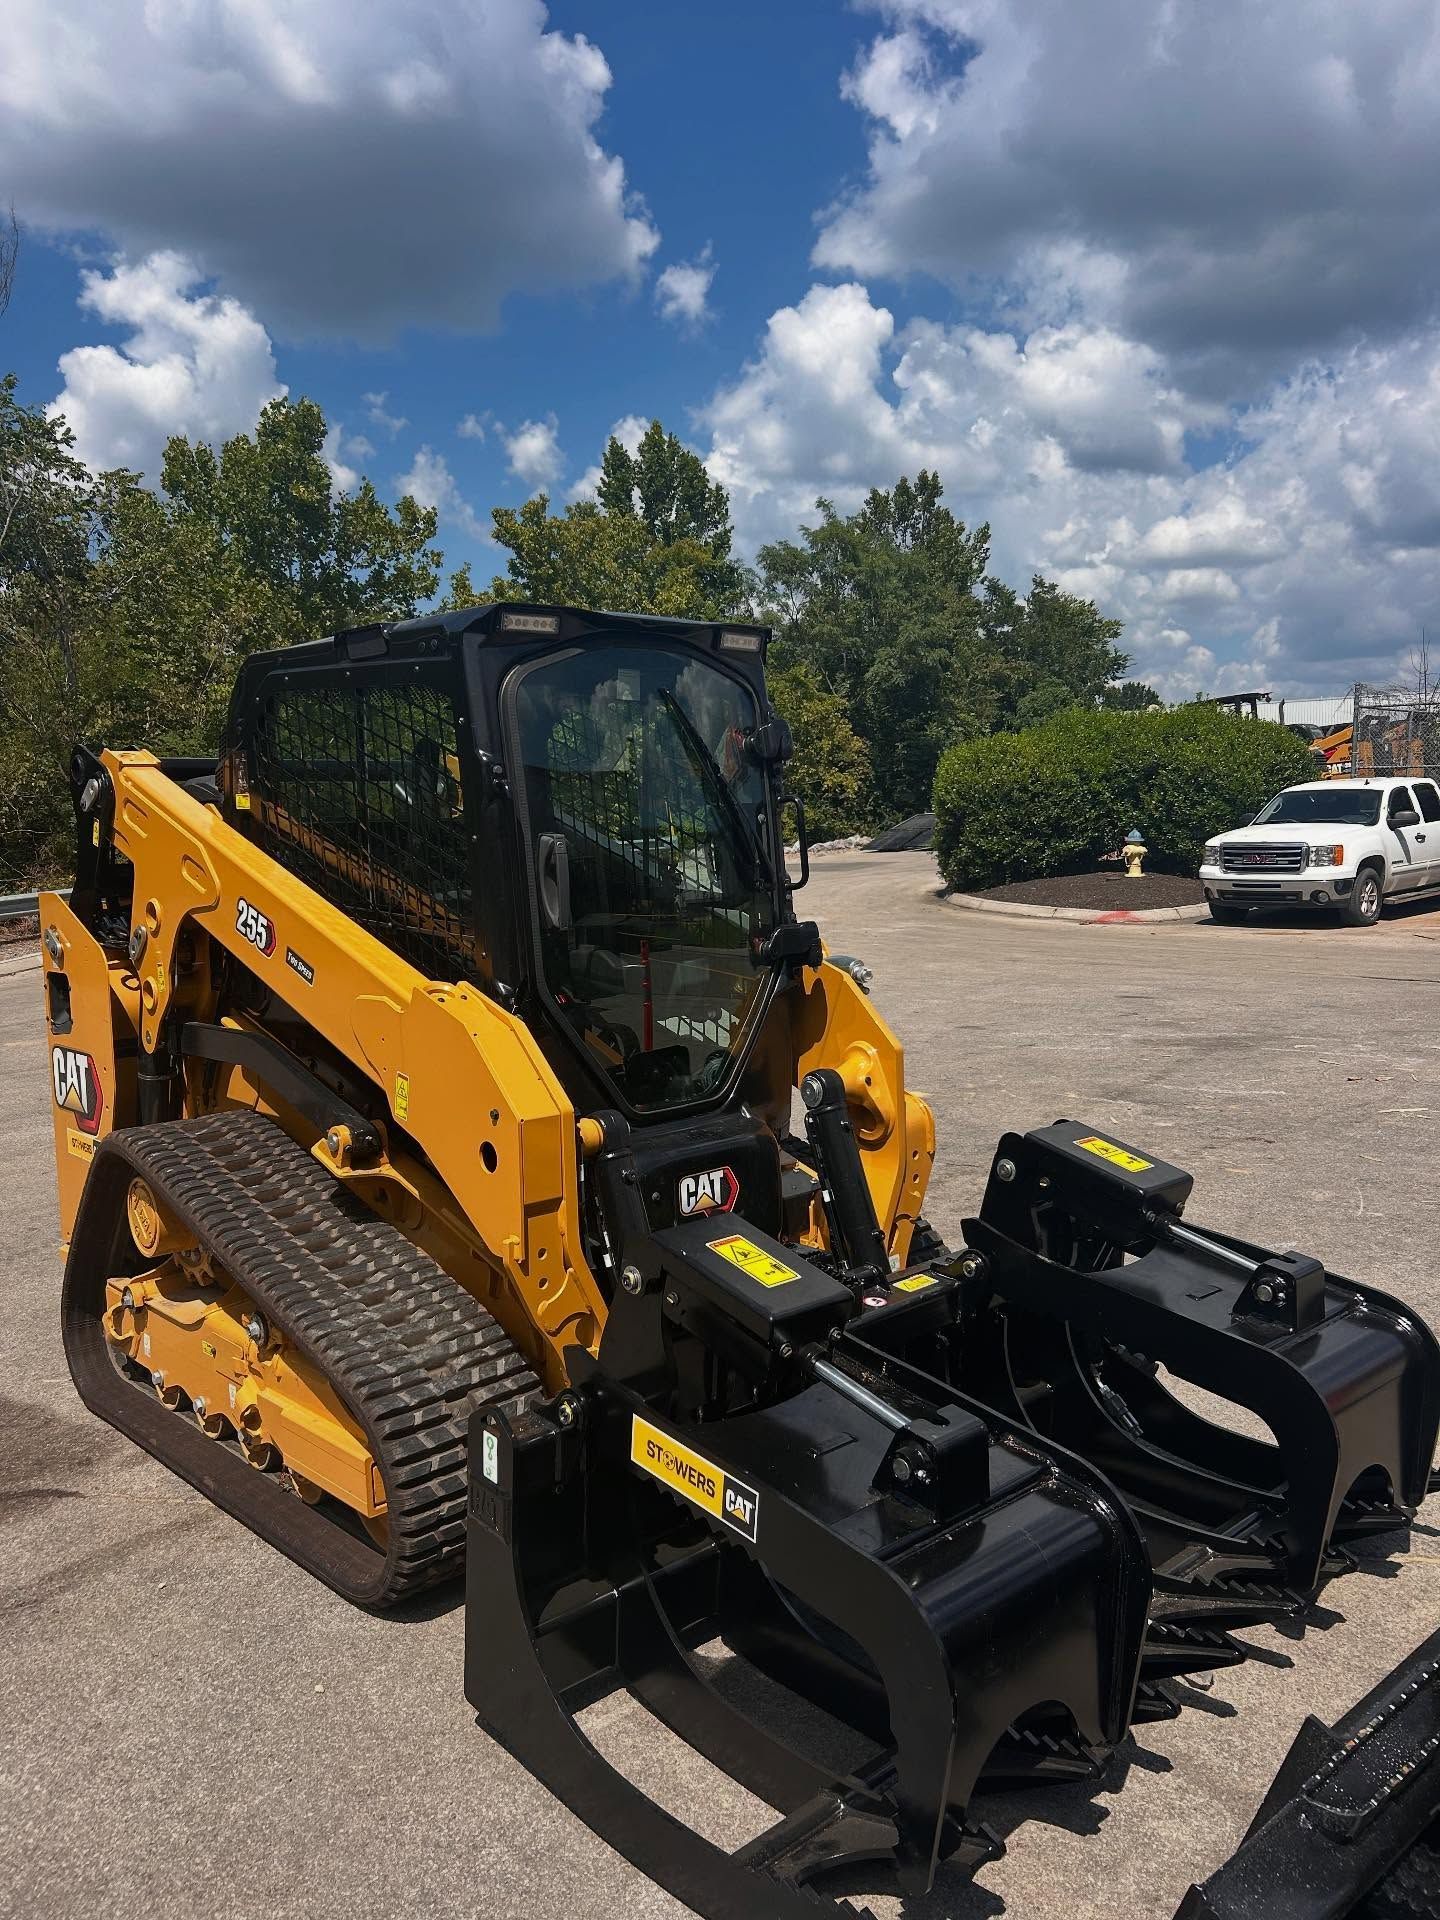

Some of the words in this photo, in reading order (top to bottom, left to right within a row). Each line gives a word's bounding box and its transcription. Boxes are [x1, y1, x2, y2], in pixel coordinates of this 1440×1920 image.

[236, 898, 268, 950] 255
[53, 1047, 89, 1114] CAT
[680, 1169, 724, 1214] CAT
[646, 1439, 716, 1499] STOWERS
[725, 1488, 753, 1525] CAT
